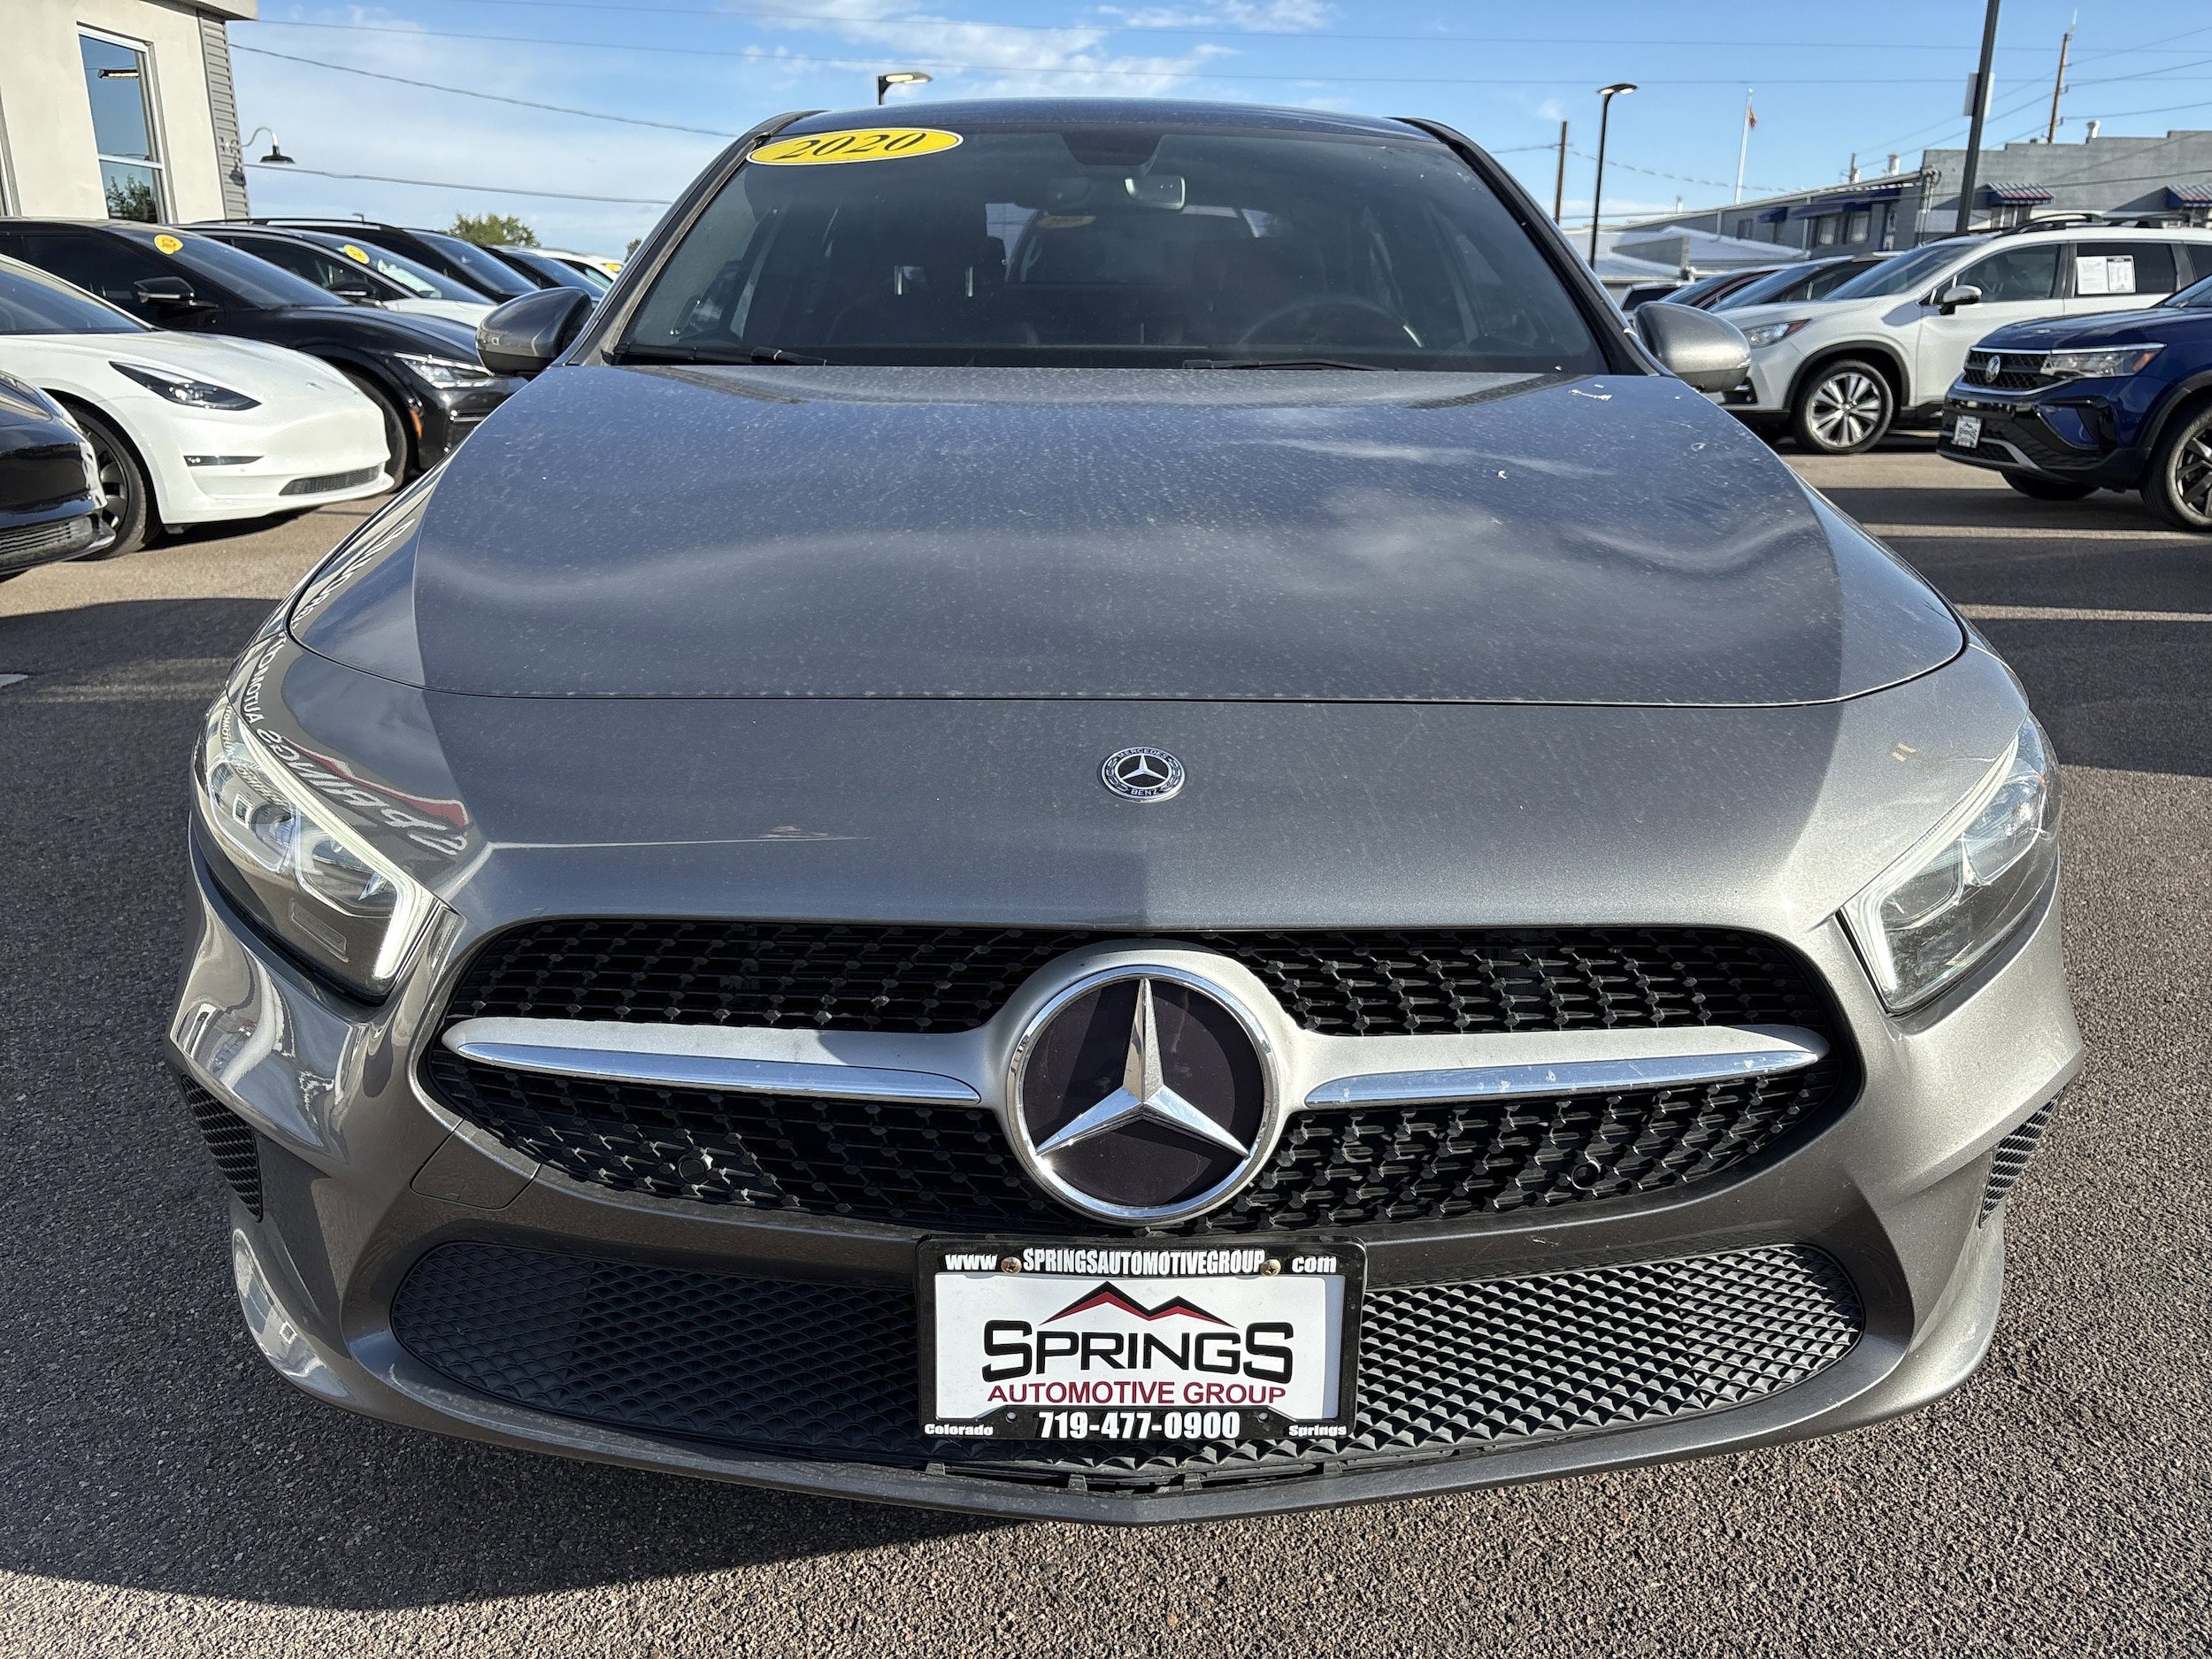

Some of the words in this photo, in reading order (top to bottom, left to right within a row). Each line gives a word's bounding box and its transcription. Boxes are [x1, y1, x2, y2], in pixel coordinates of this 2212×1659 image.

[772, 132, 926, 160] 2020
[1117, 748, 1169, 759] MERCEDES
[1023, 1247, 1265, 1275] SPRINGSAUTOMOTIVEGROUP
[1292, 1256, 1337, 1273] com
[982, 1319, 1294, 1385] SPRINGS
[987, 1381, 1174, 1404] AUTOMOTIVE
[1183, 1382, 1286, 1404] GROUP
[924, 1423, 994, 1436] Colorado
[1038, 1410, 1240, 1440] 719-477-0900
[1288, 1425, 1347, 1437] Springs
